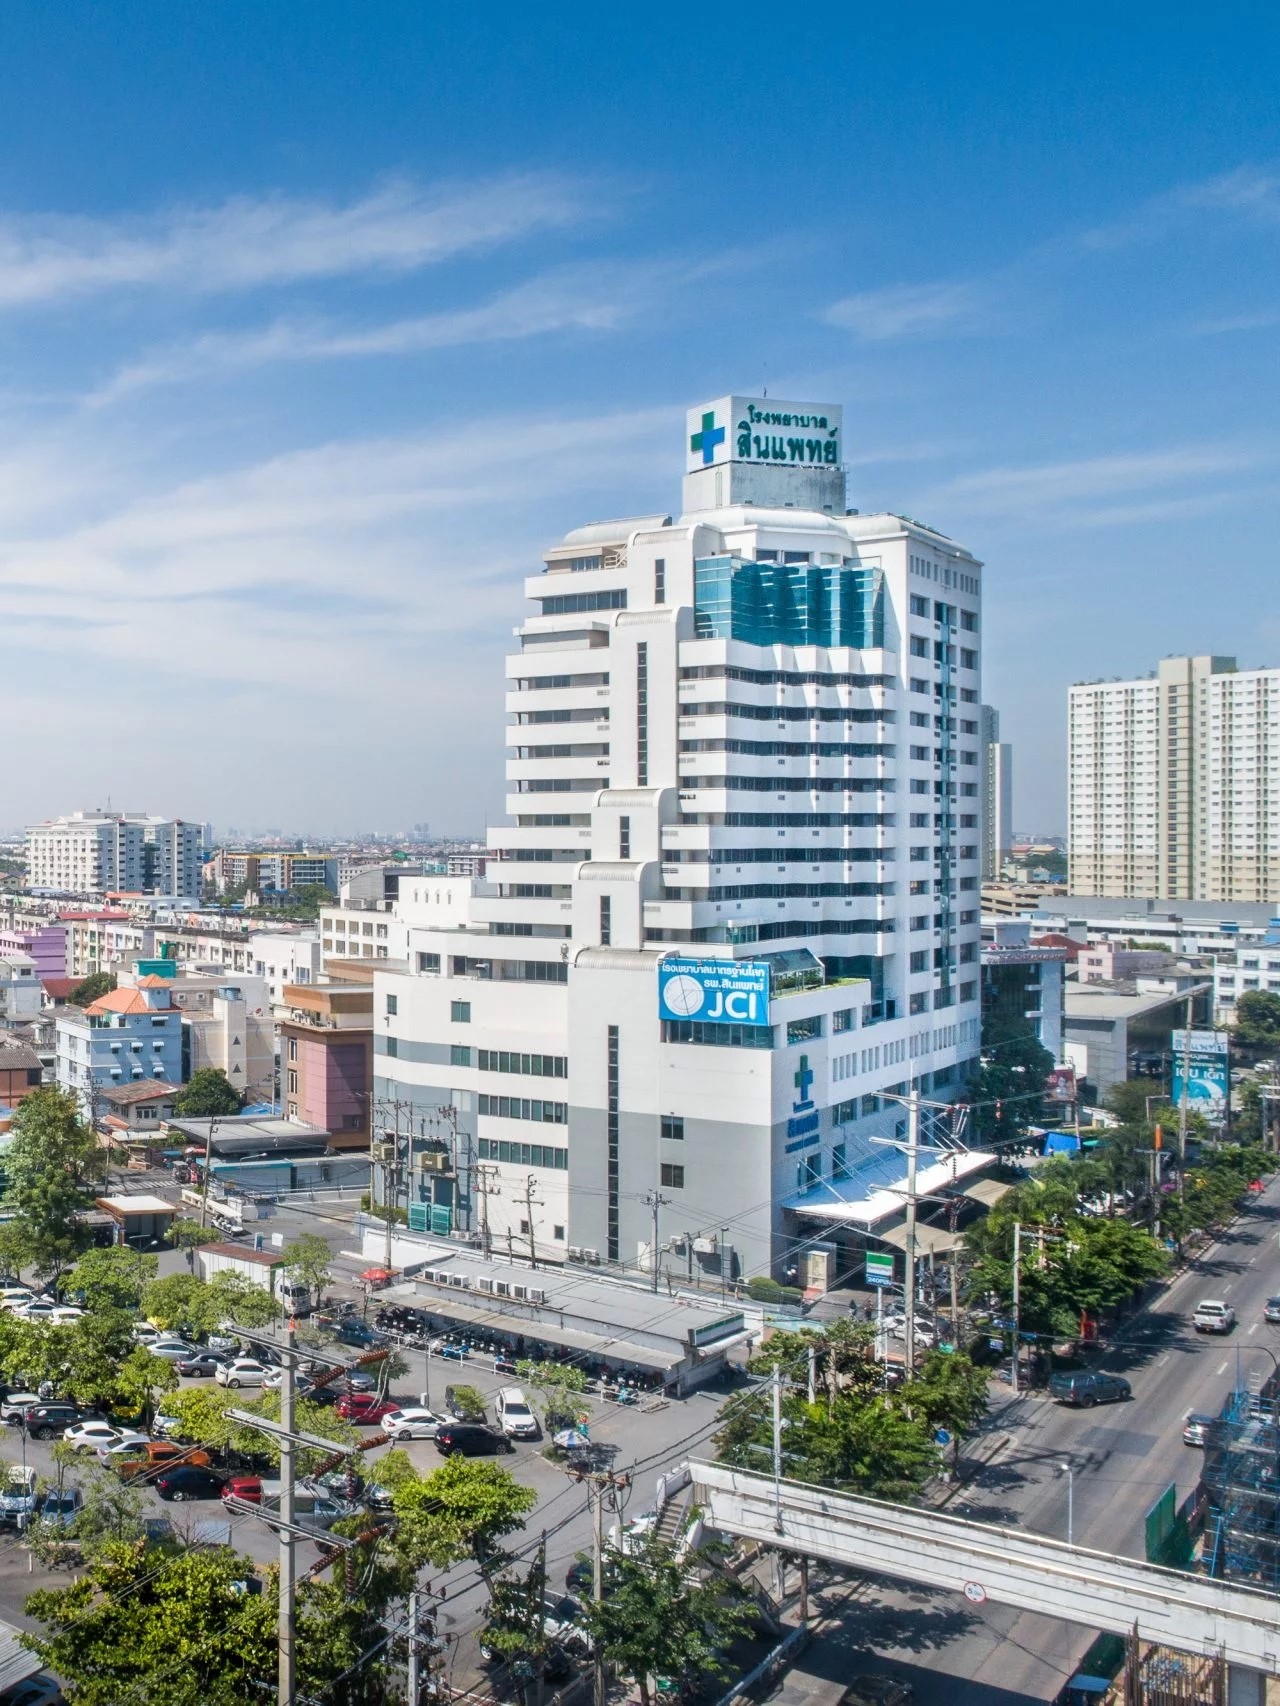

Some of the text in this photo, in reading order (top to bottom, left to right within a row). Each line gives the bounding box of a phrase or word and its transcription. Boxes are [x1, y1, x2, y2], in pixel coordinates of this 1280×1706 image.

[747, 404, 828, 429] โรงพยาบาล
[736, 420, 838, 464] สินแพทย์
[707, 991, 757, 1020] JCI
